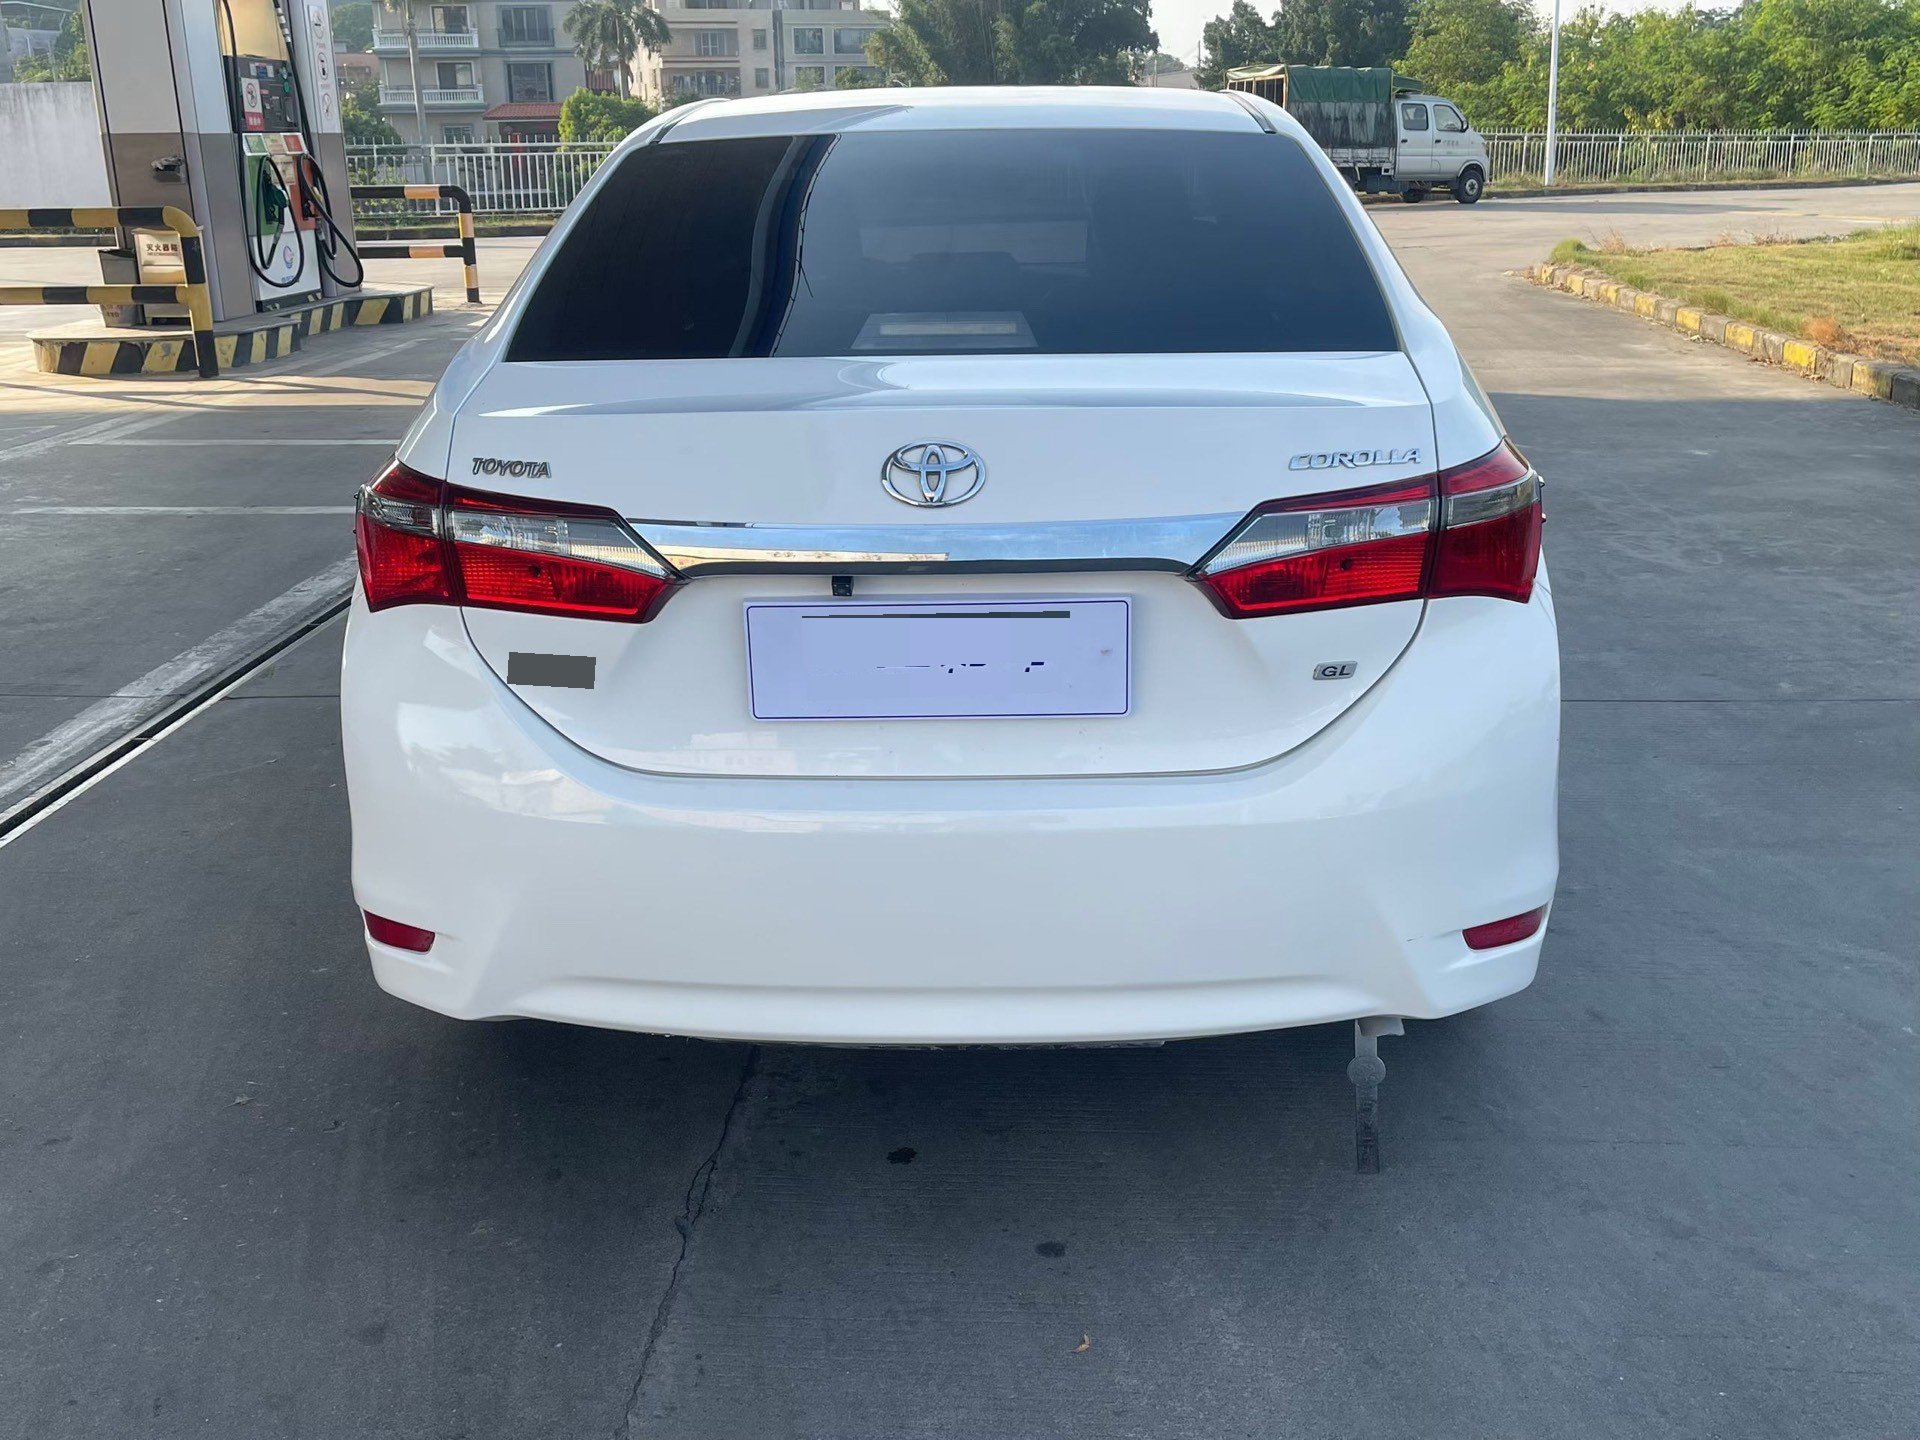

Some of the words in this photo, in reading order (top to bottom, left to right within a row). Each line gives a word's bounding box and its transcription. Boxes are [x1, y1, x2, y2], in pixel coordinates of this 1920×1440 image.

[472, 457, 552, 479] TOYOTA
[1288, 448, 1422, 471] COROLLA
[1321, 665, 1351, 677] GL
